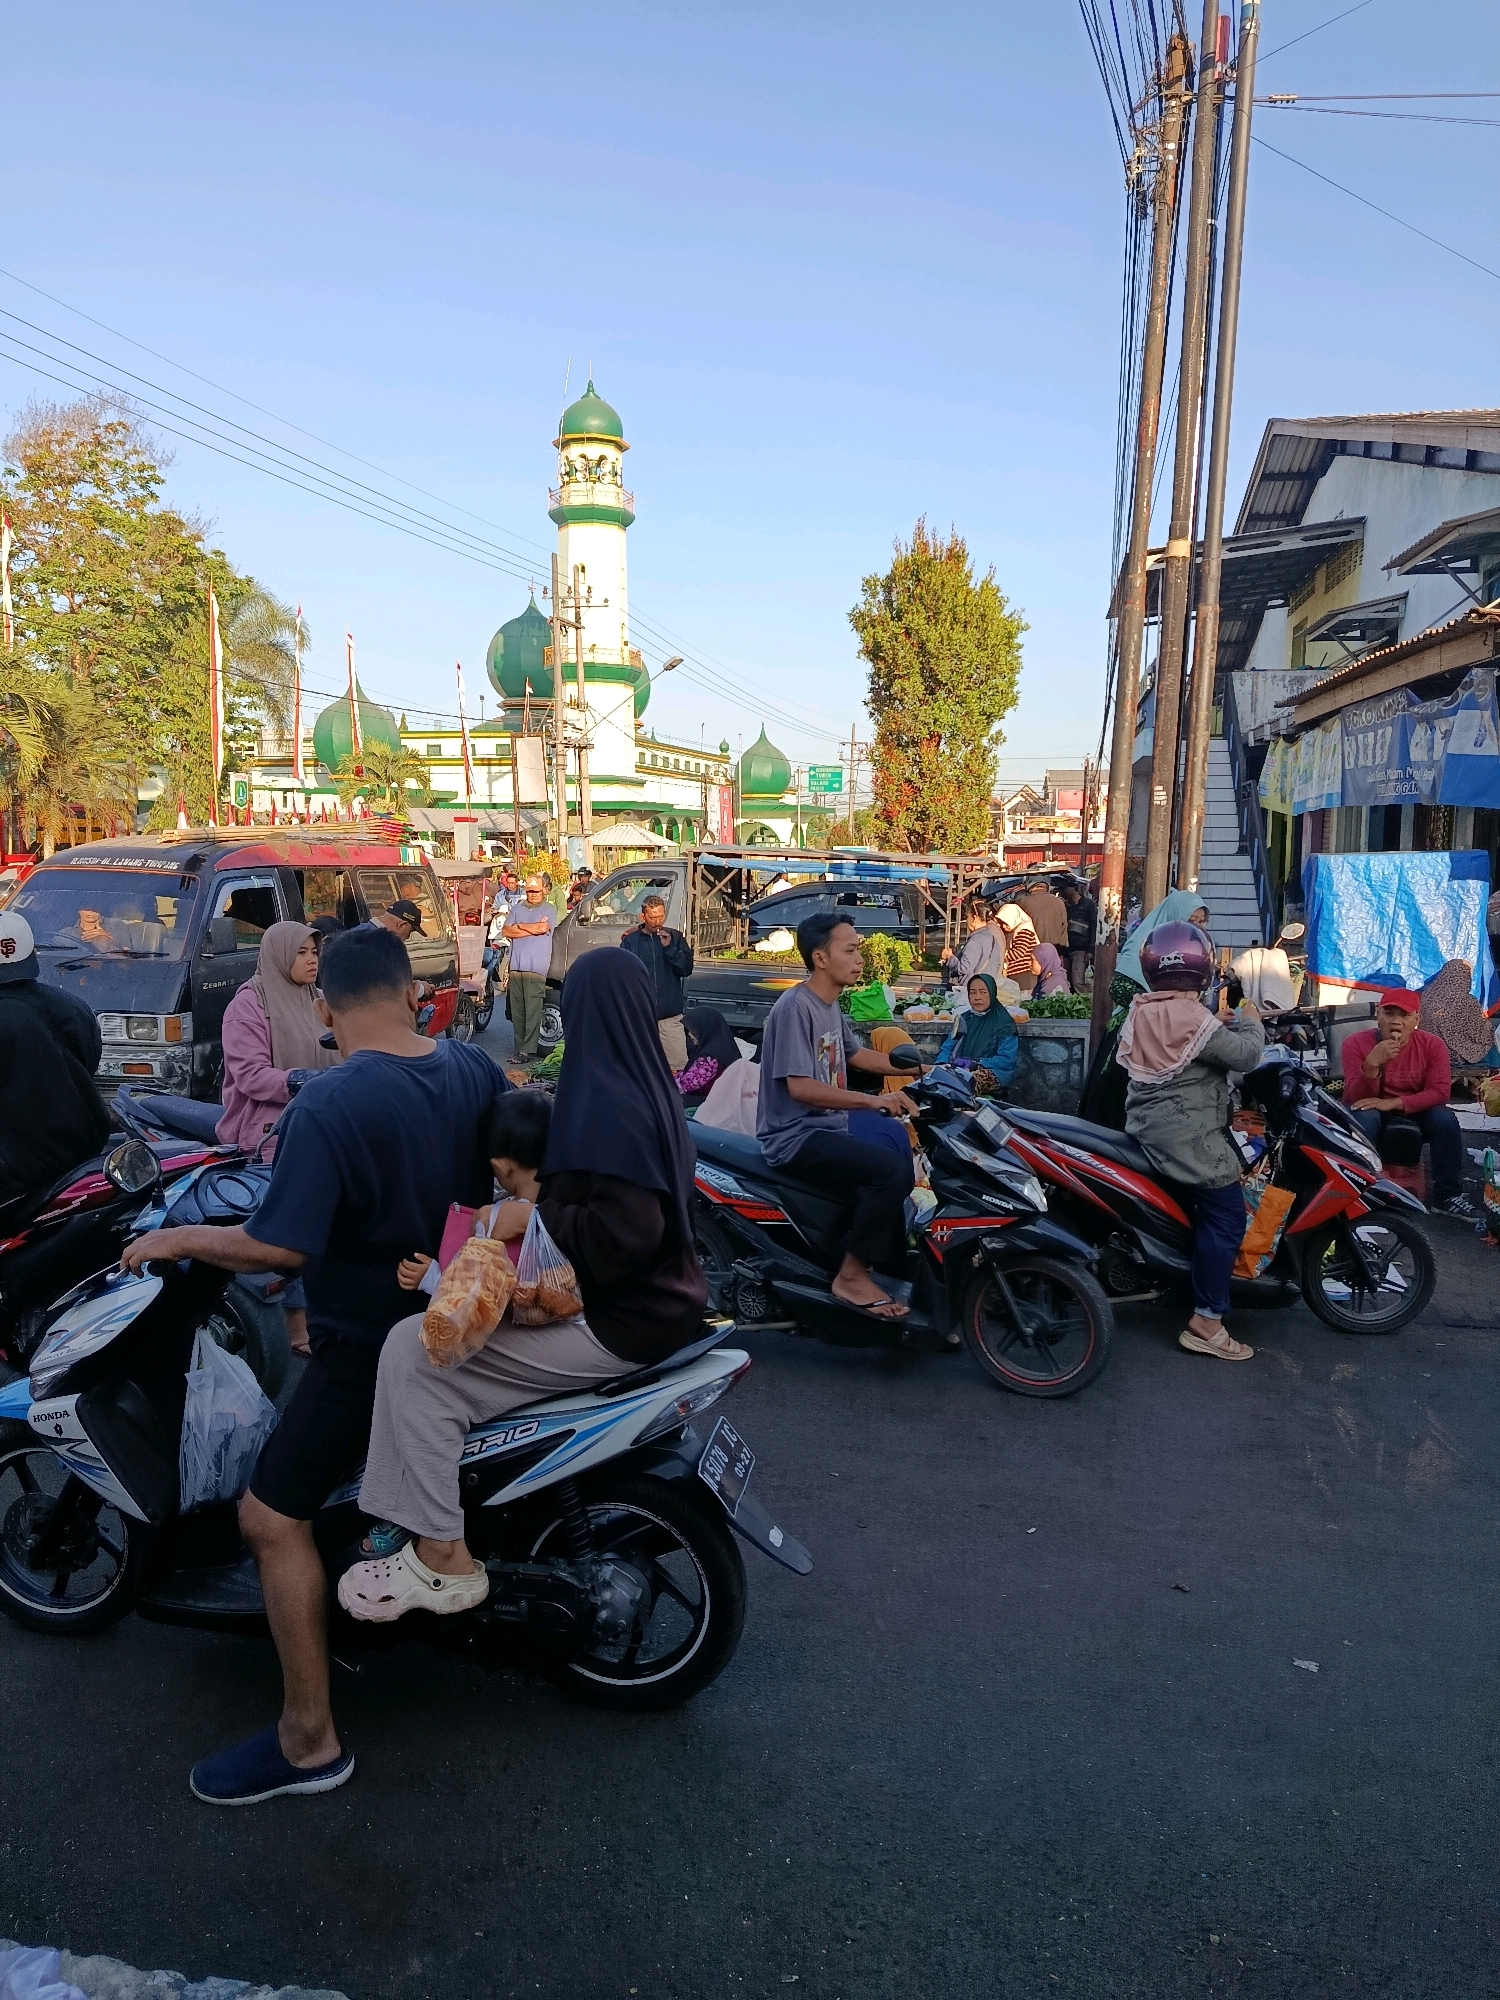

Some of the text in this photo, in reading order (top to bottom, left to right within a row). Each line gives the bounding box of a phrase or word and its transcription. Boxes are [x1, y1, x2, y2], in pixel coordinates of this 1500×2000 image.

[1342, 1168, 1367, 1186] HONDA
[981, 1194, 1014, 1211] HONDA
[33, 1409, 71, 1423] HONDA
[462, 1420, 541, 1460] ARIO
